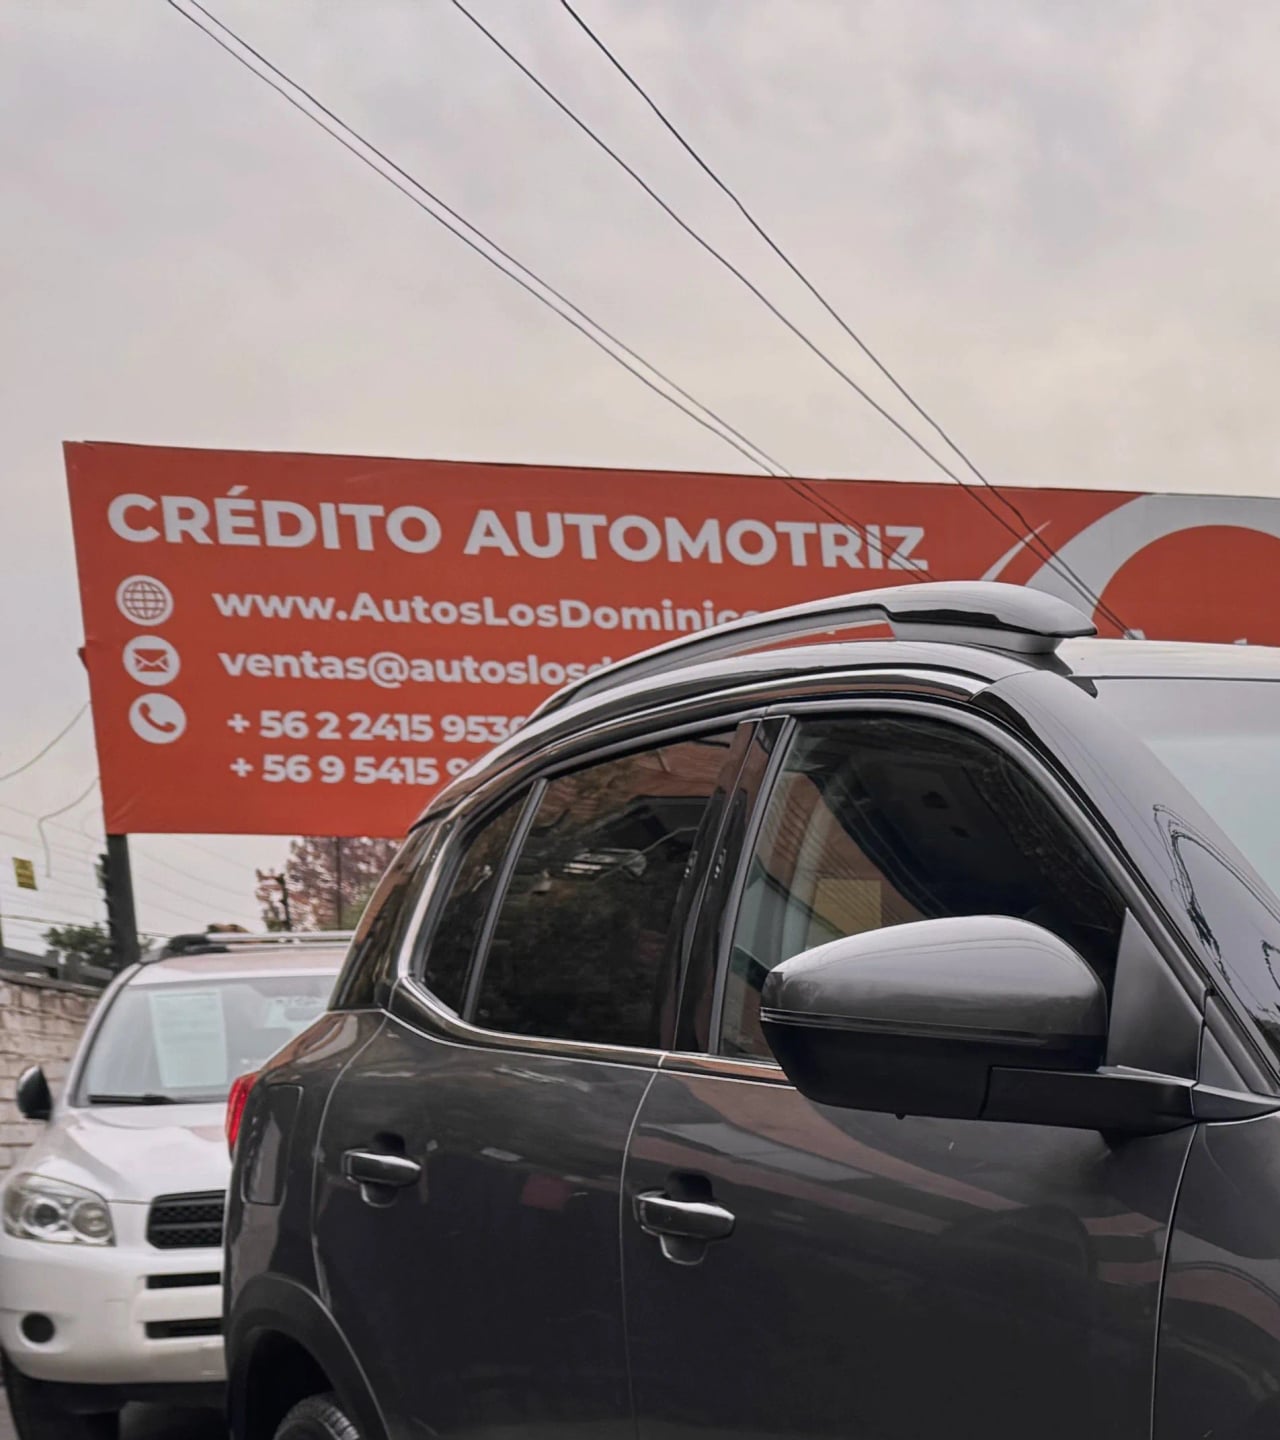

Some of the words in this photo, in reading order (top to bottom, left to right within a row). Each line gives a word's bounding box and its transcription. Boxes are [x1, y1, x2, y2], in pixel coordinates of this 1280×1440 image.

[108, 485, 442, 554] CRÉDITO
[464, 510, 929, 571] AUTOMOTRIZ
[213, 592, 762, 632] www.AutosLosDominic
[260, 710, 309, 740] 56
[316, 711, 341, 740] 2
[348, 712, 434, 742] 2415
[263, 754, 312, 784] 56
[318, 755, 345, 784] 9
[354, 756, 439, 786] 5415
